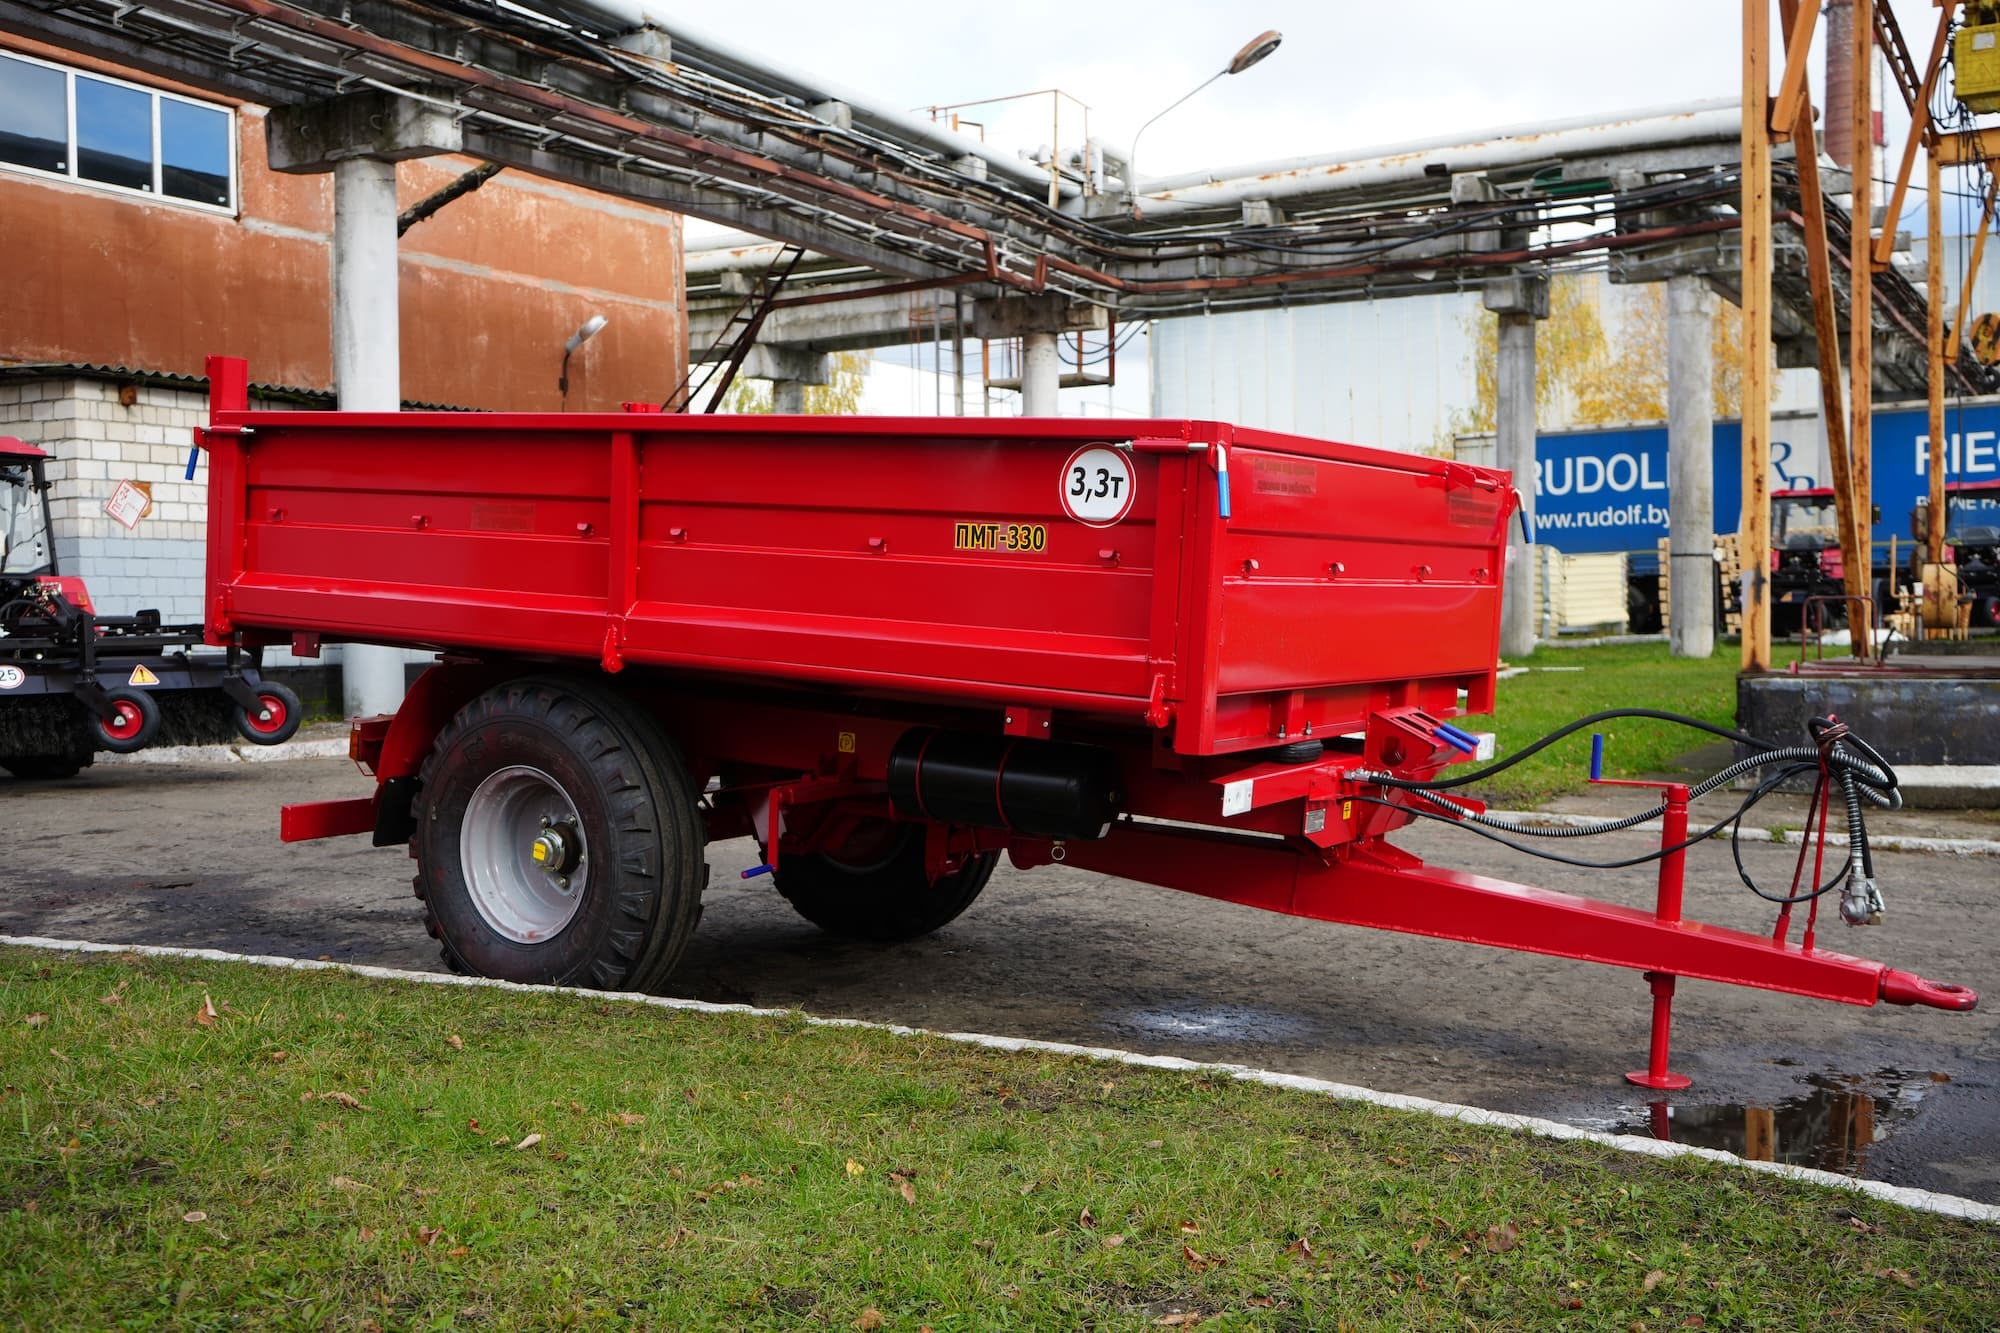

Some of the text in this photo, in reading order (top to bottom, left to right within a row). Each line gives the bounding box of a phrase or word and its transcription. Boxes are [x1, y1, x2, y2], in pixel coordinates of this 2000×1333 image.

[1535, 452, 1669, 496] UDOL
[1915, 431, 2000, 475] RIE
[955, 523, 1046, 551] ПМТ-330
